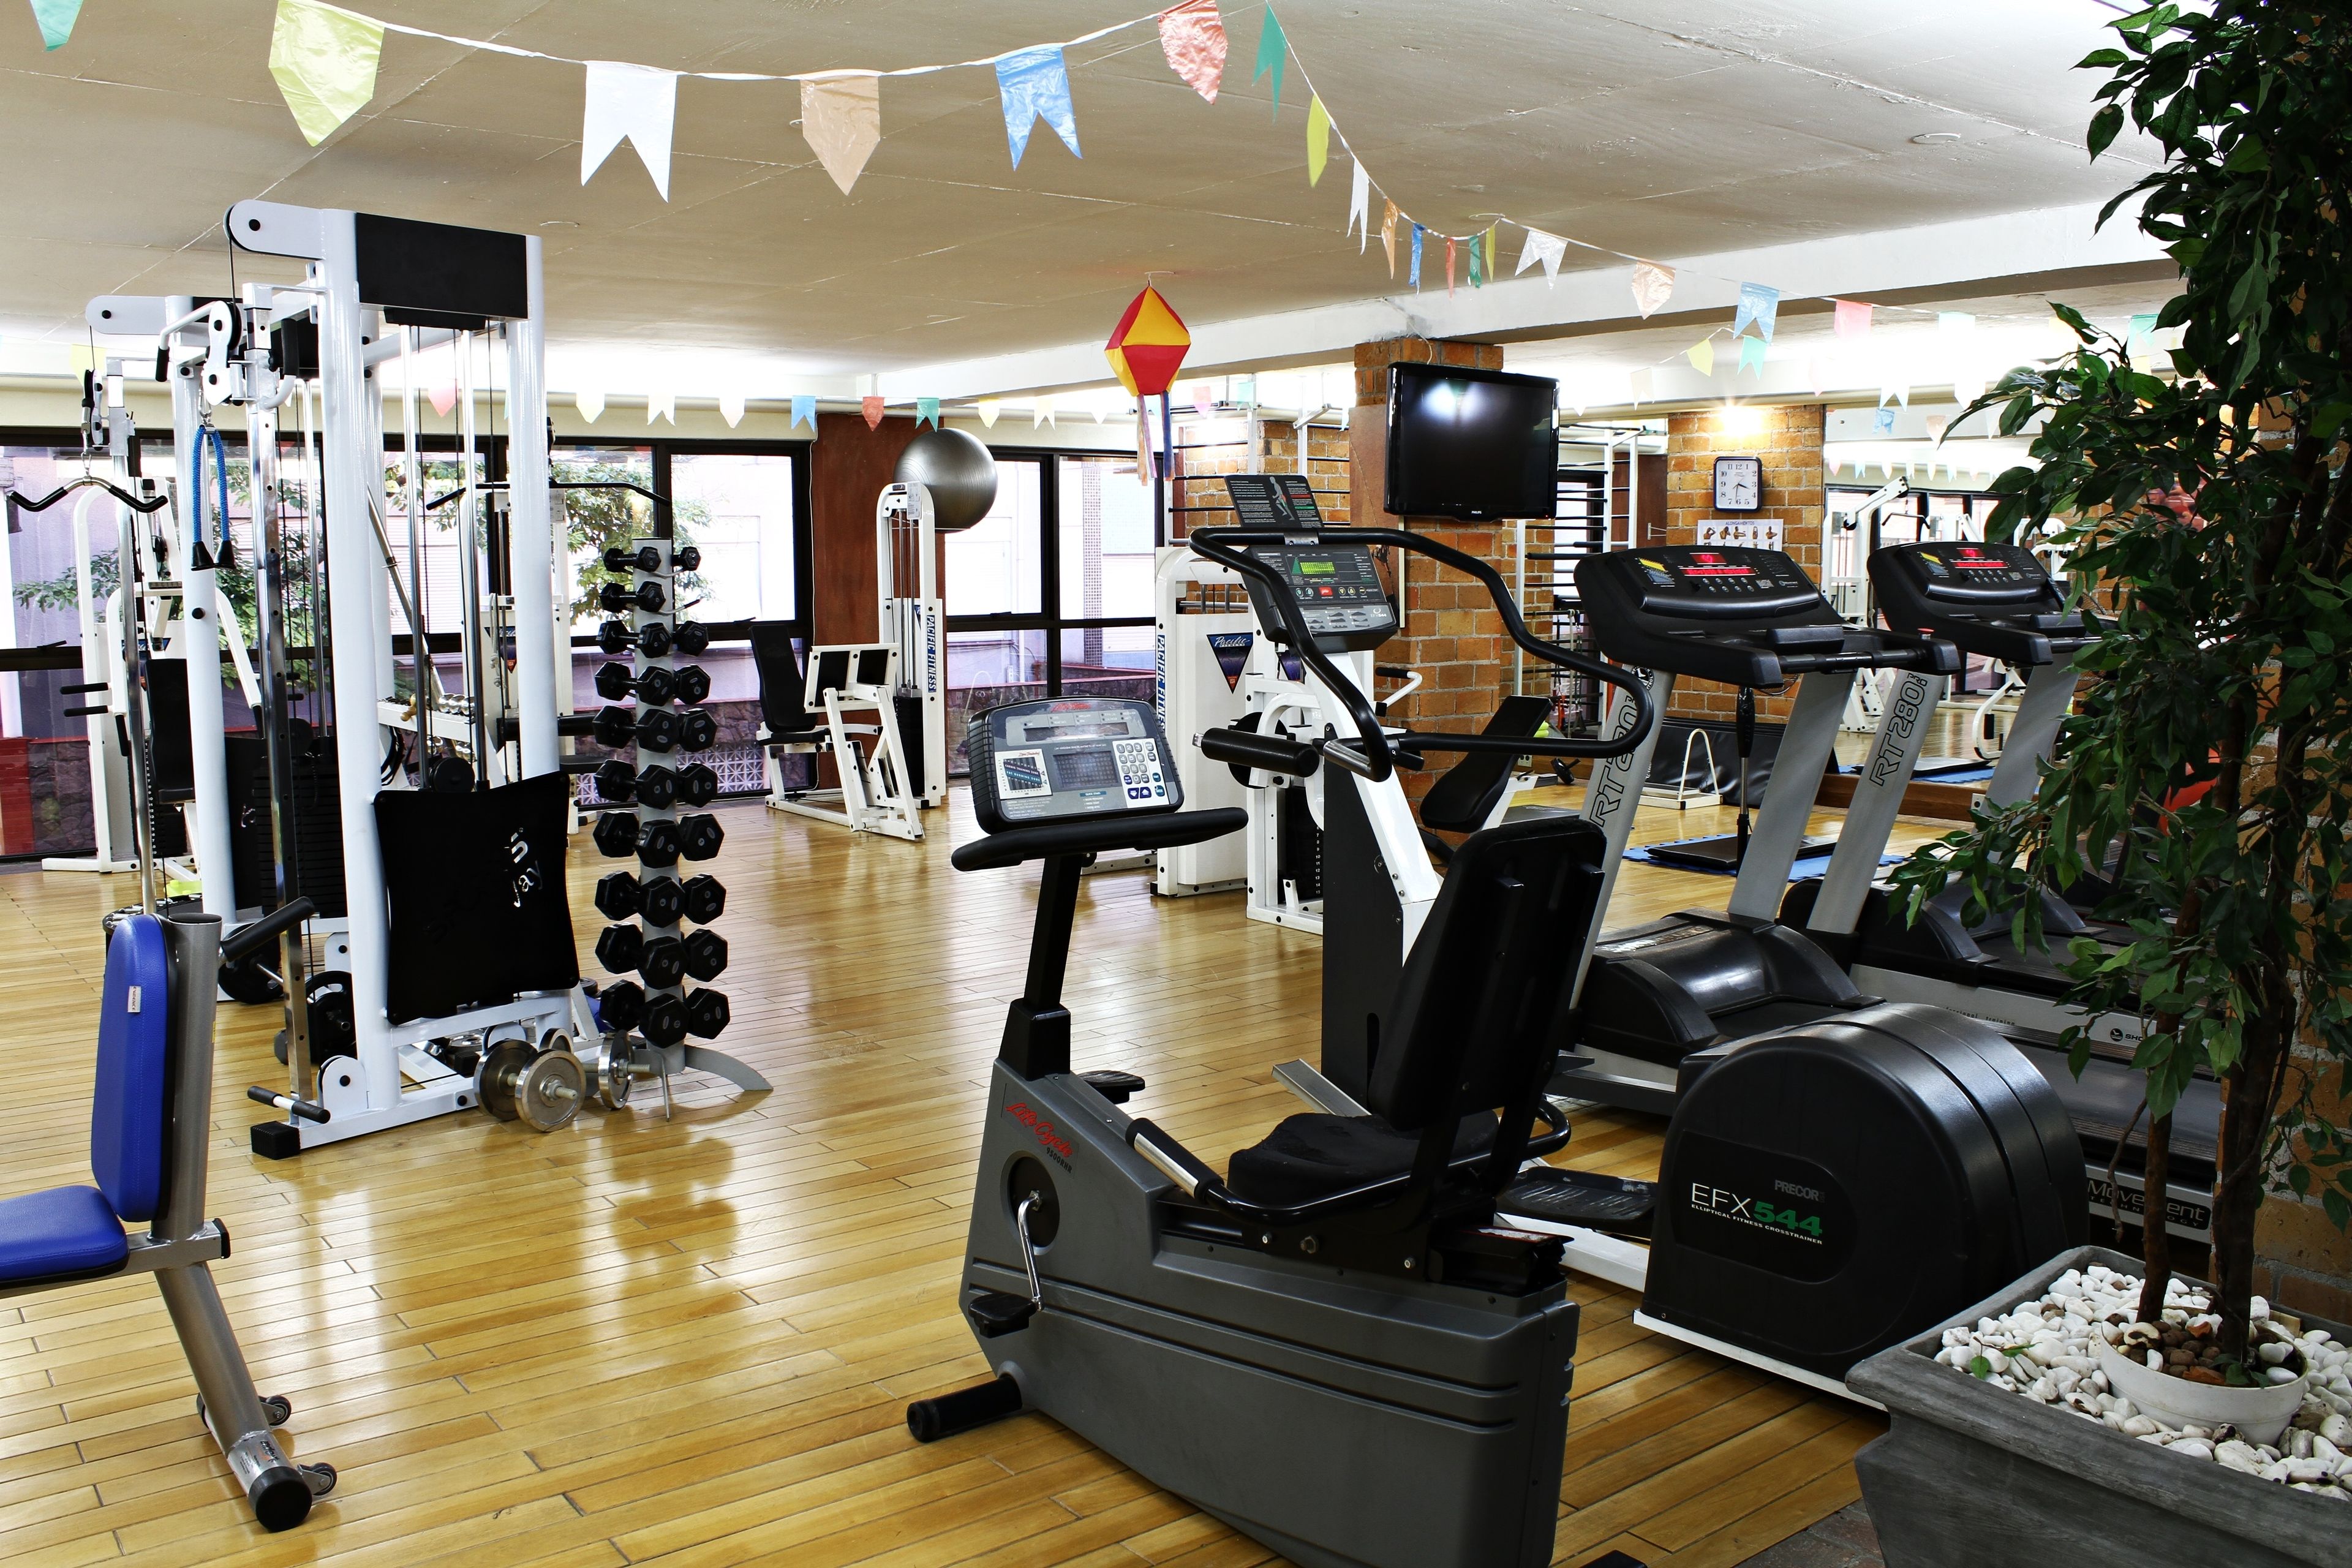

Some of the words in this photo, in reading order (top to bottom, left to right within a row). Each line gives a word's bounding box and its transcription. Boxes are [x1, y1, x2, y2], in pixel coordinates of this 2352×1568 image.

[1214, 635, 1250, 647] Pacific
[1774, 1179, 1819, 1201] PRECOR
[1691, 1204, 1731, 1219] ELLIPTICAL
[1733, 1216, 1763, 1227] FITNESS
[1765, 1225, 1823, 1245] CROSSTRAINER
